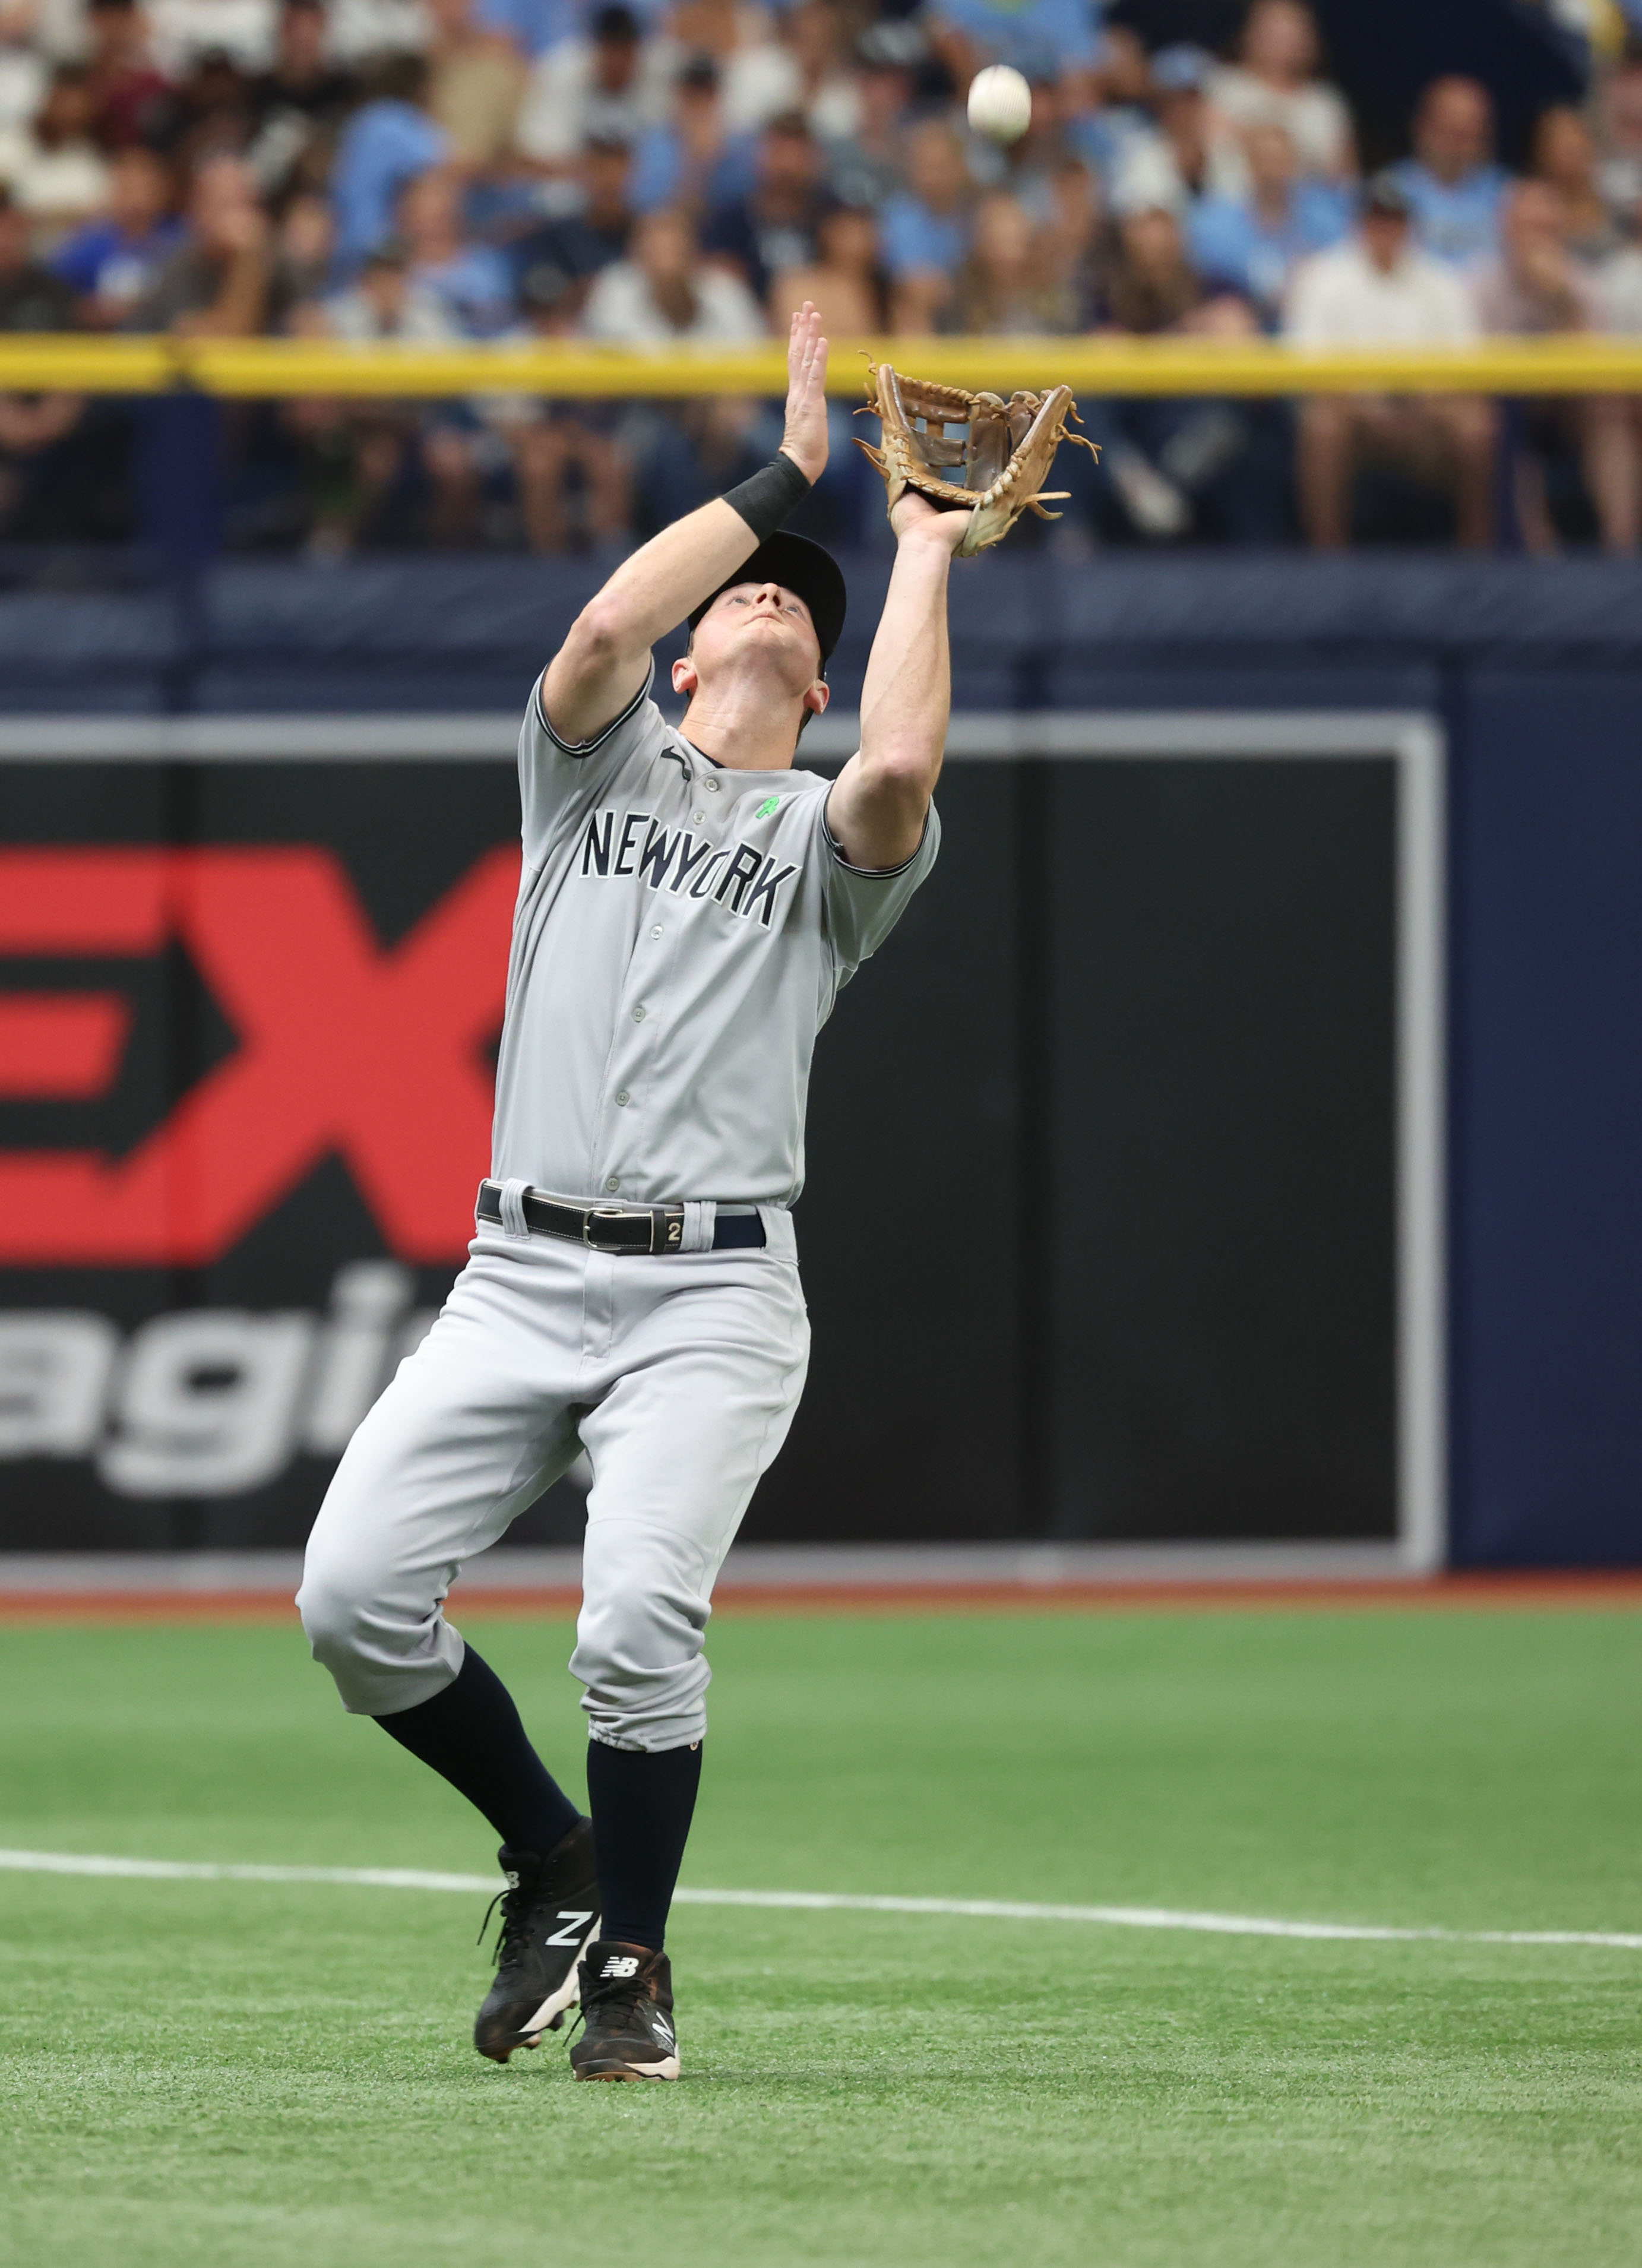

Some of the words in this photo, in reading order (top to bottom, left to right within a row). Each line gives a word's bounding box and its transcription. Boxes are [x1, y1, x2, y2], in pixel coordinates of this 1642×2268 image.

[579, 808, 682, 892] NEW
[665, 828, 803, 931] YORK
[668, 1222, 681, 1241] 2
[0, 1259, 442, 1500] agi
